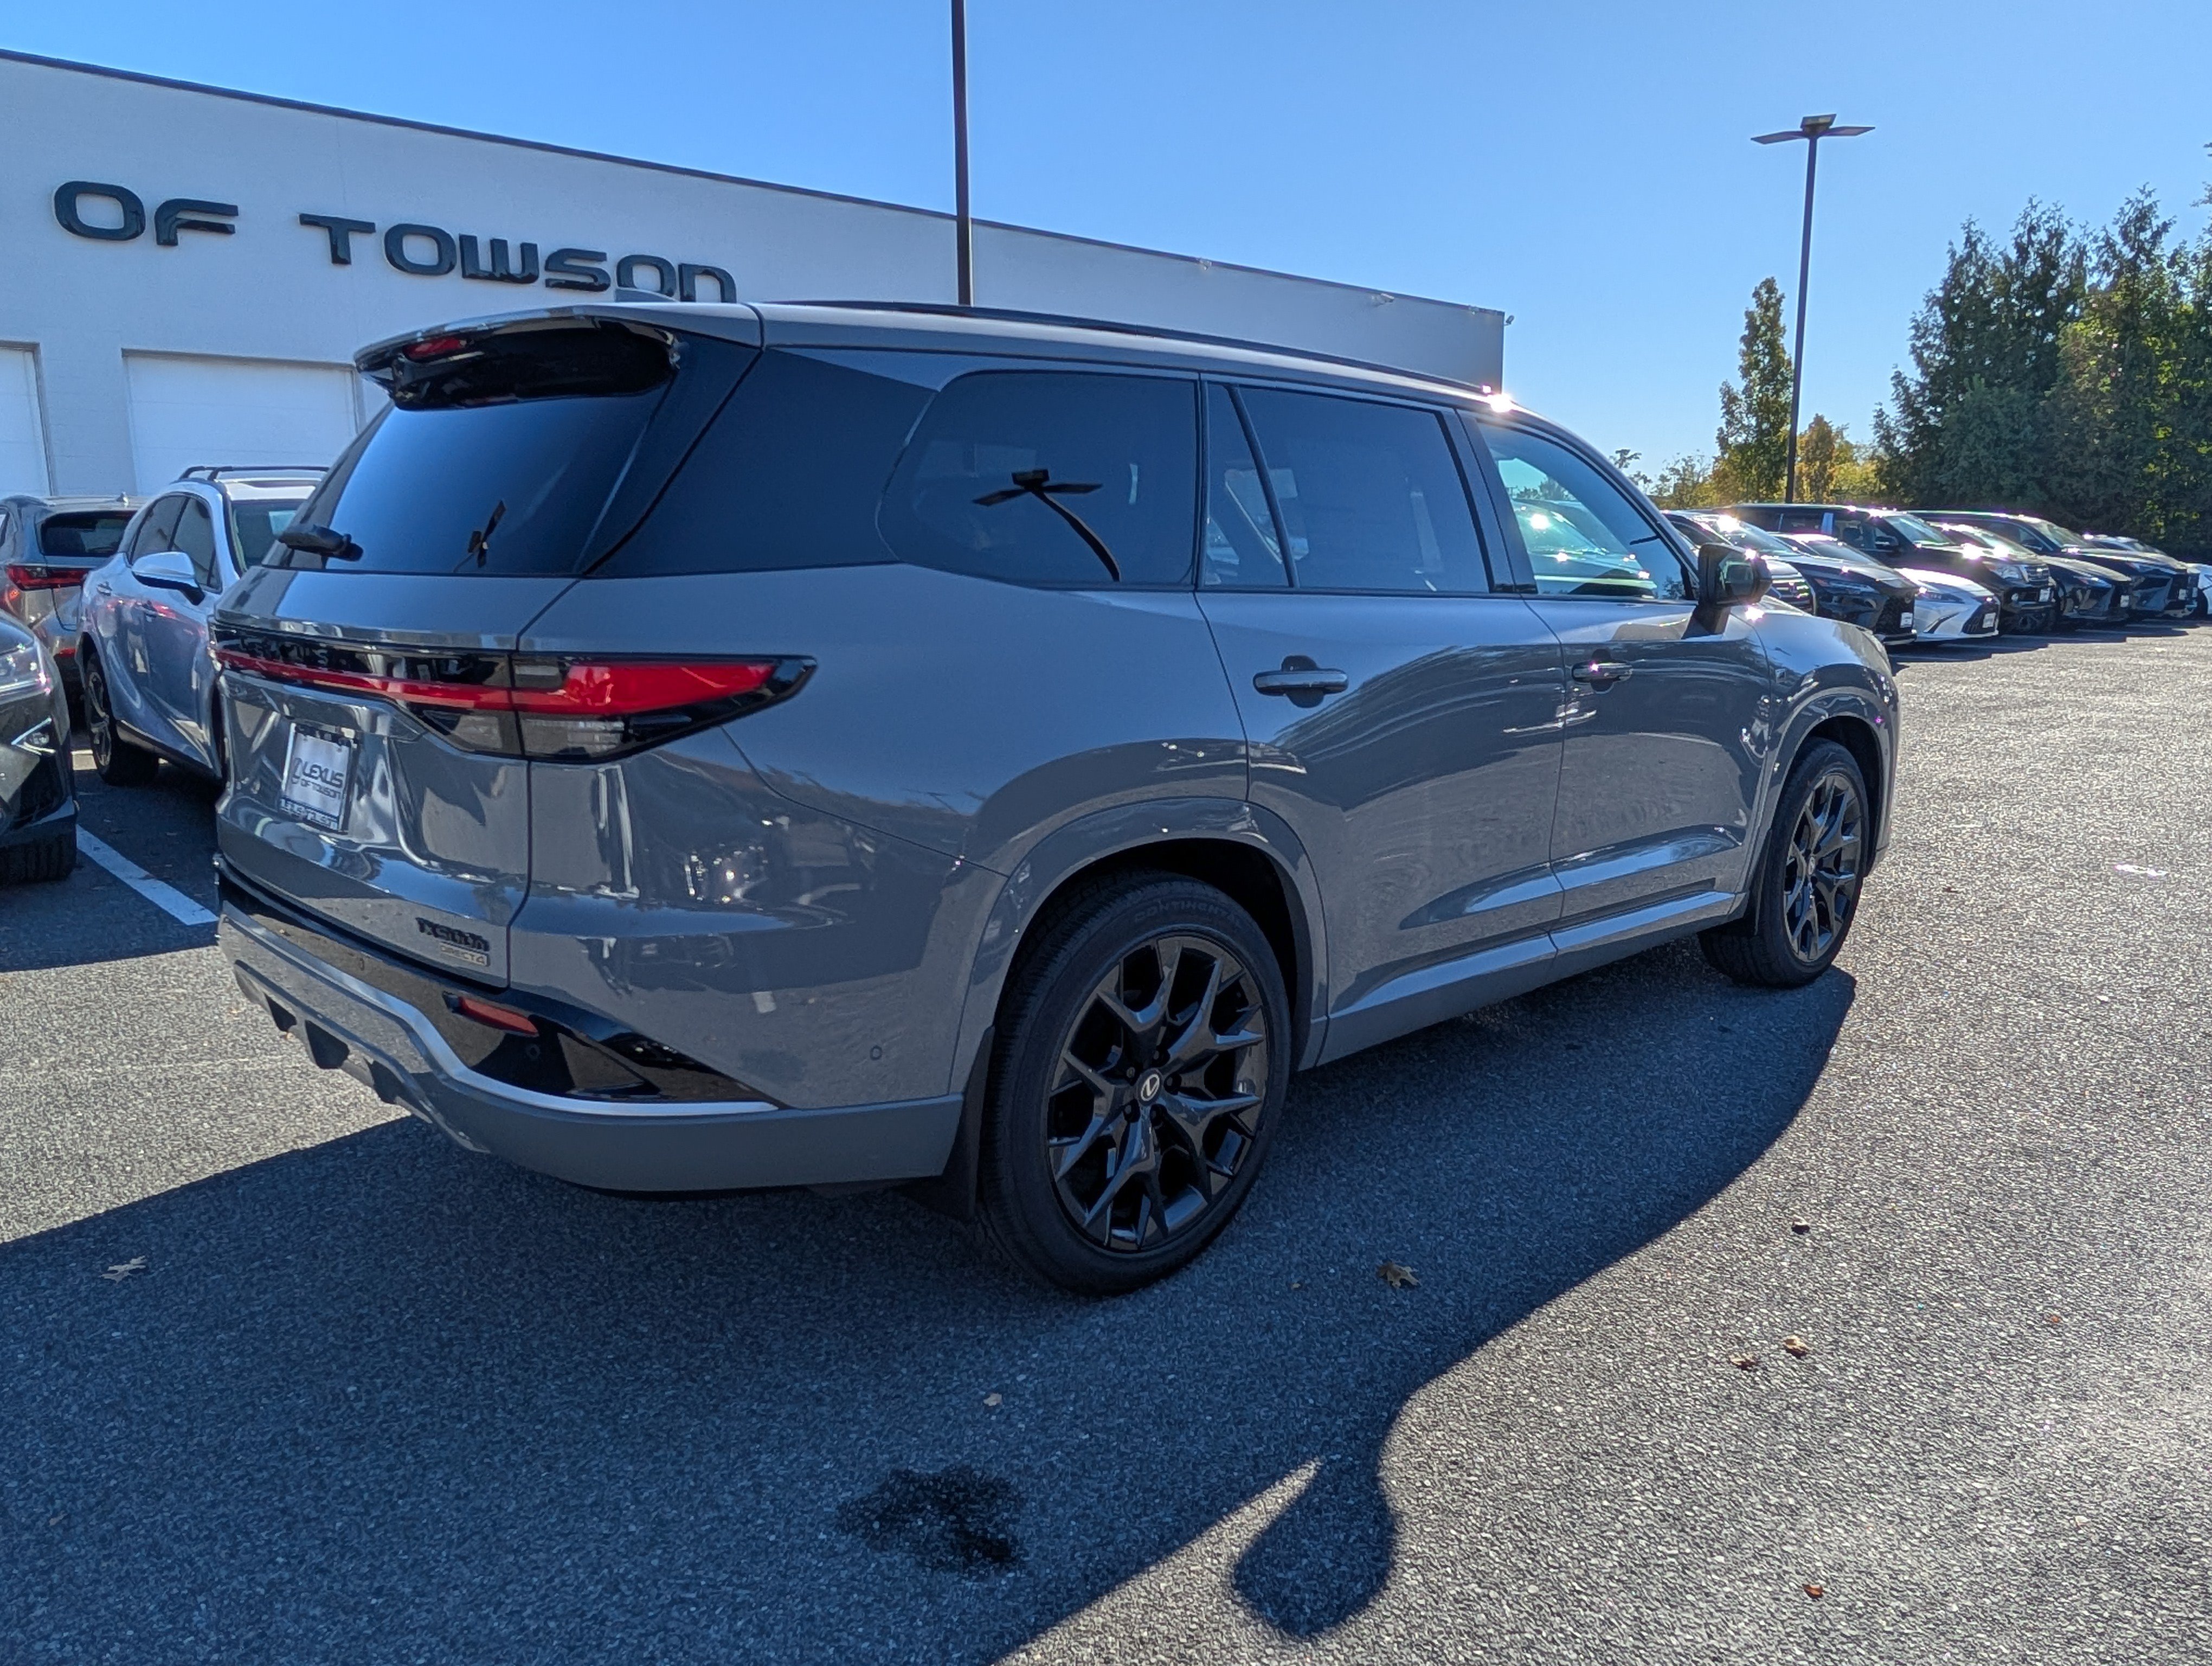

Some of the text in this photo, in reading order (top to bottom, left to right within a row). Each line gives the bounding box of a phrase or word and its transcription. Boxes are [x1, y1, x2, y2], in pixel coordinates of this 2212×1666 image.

[54, 181, 736, 303] OF TOWSON
[303, 761, 343, 789] LEXUS
